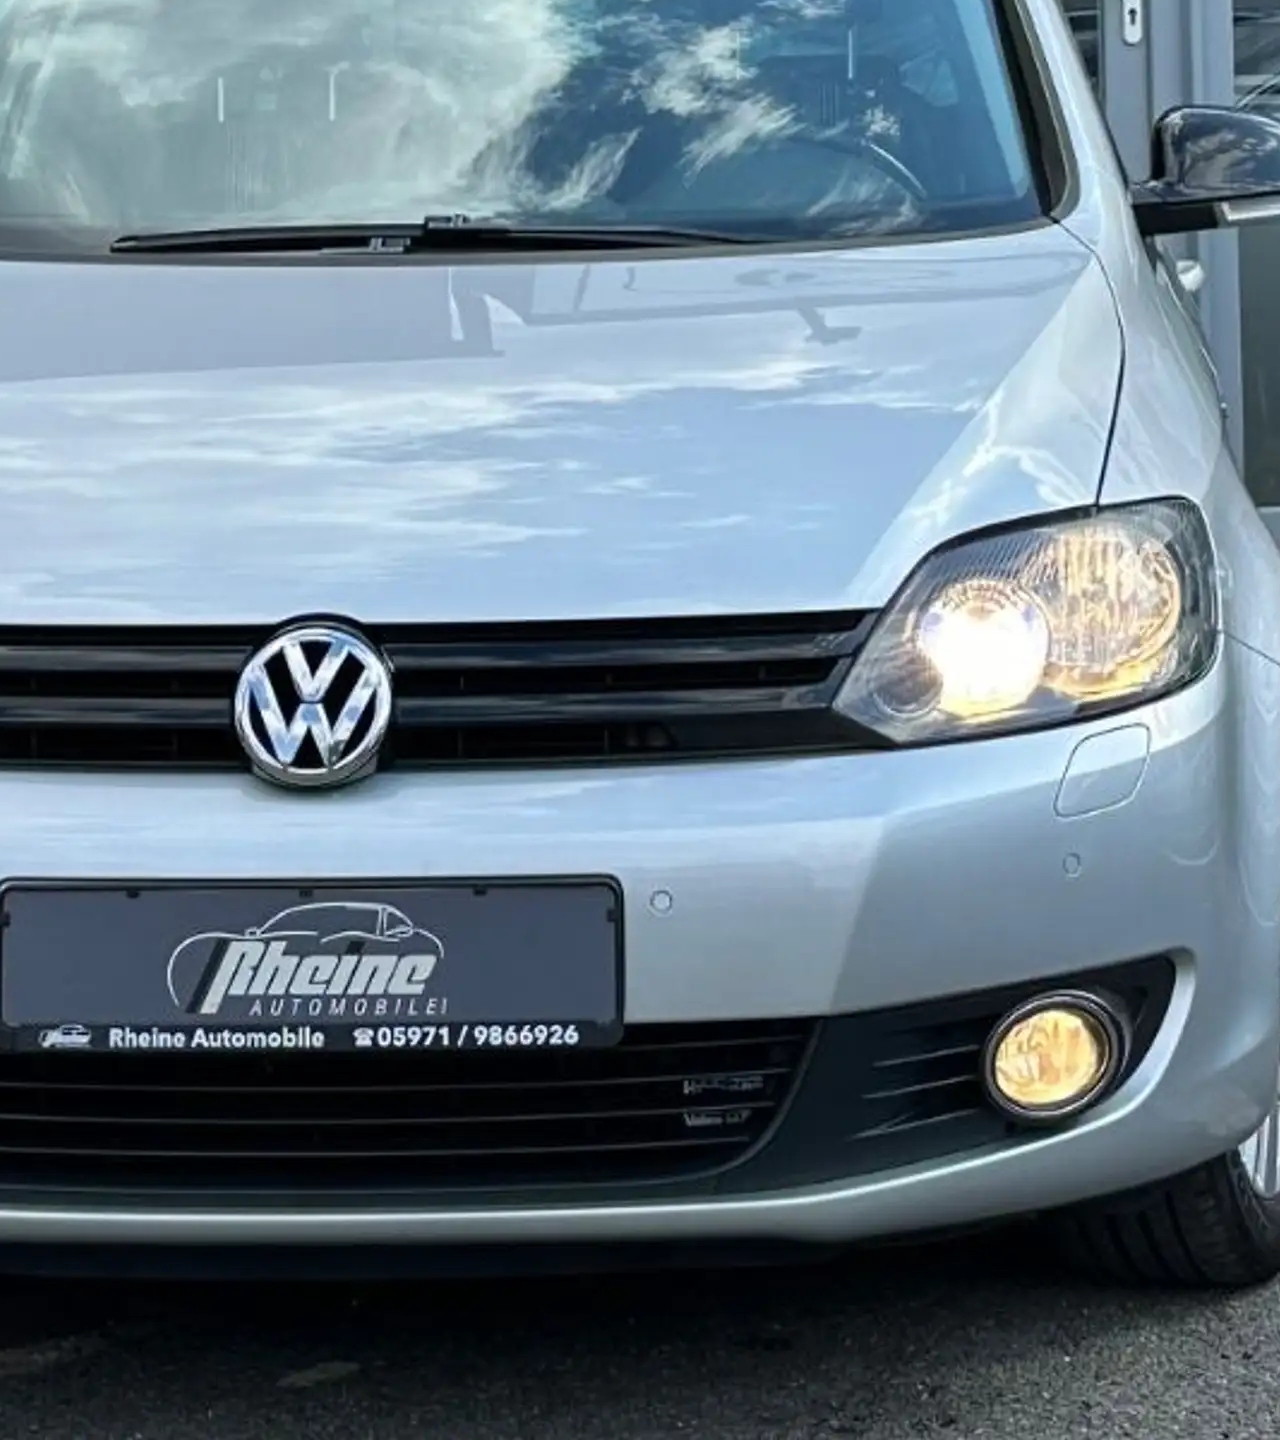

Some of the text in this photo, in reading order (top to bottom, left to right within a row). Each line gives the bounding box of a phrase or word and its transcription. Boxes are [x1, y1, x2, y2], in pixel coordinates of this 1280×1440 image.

[199, 939, 443, 1015] Rheine
[108, 1026, 186, 1049] Rheine
[190, 1025, 326, 1049] Automobile
[376, 1025, 451, 1048] 05971
[473, 1023, 580, 1048] 9866926
